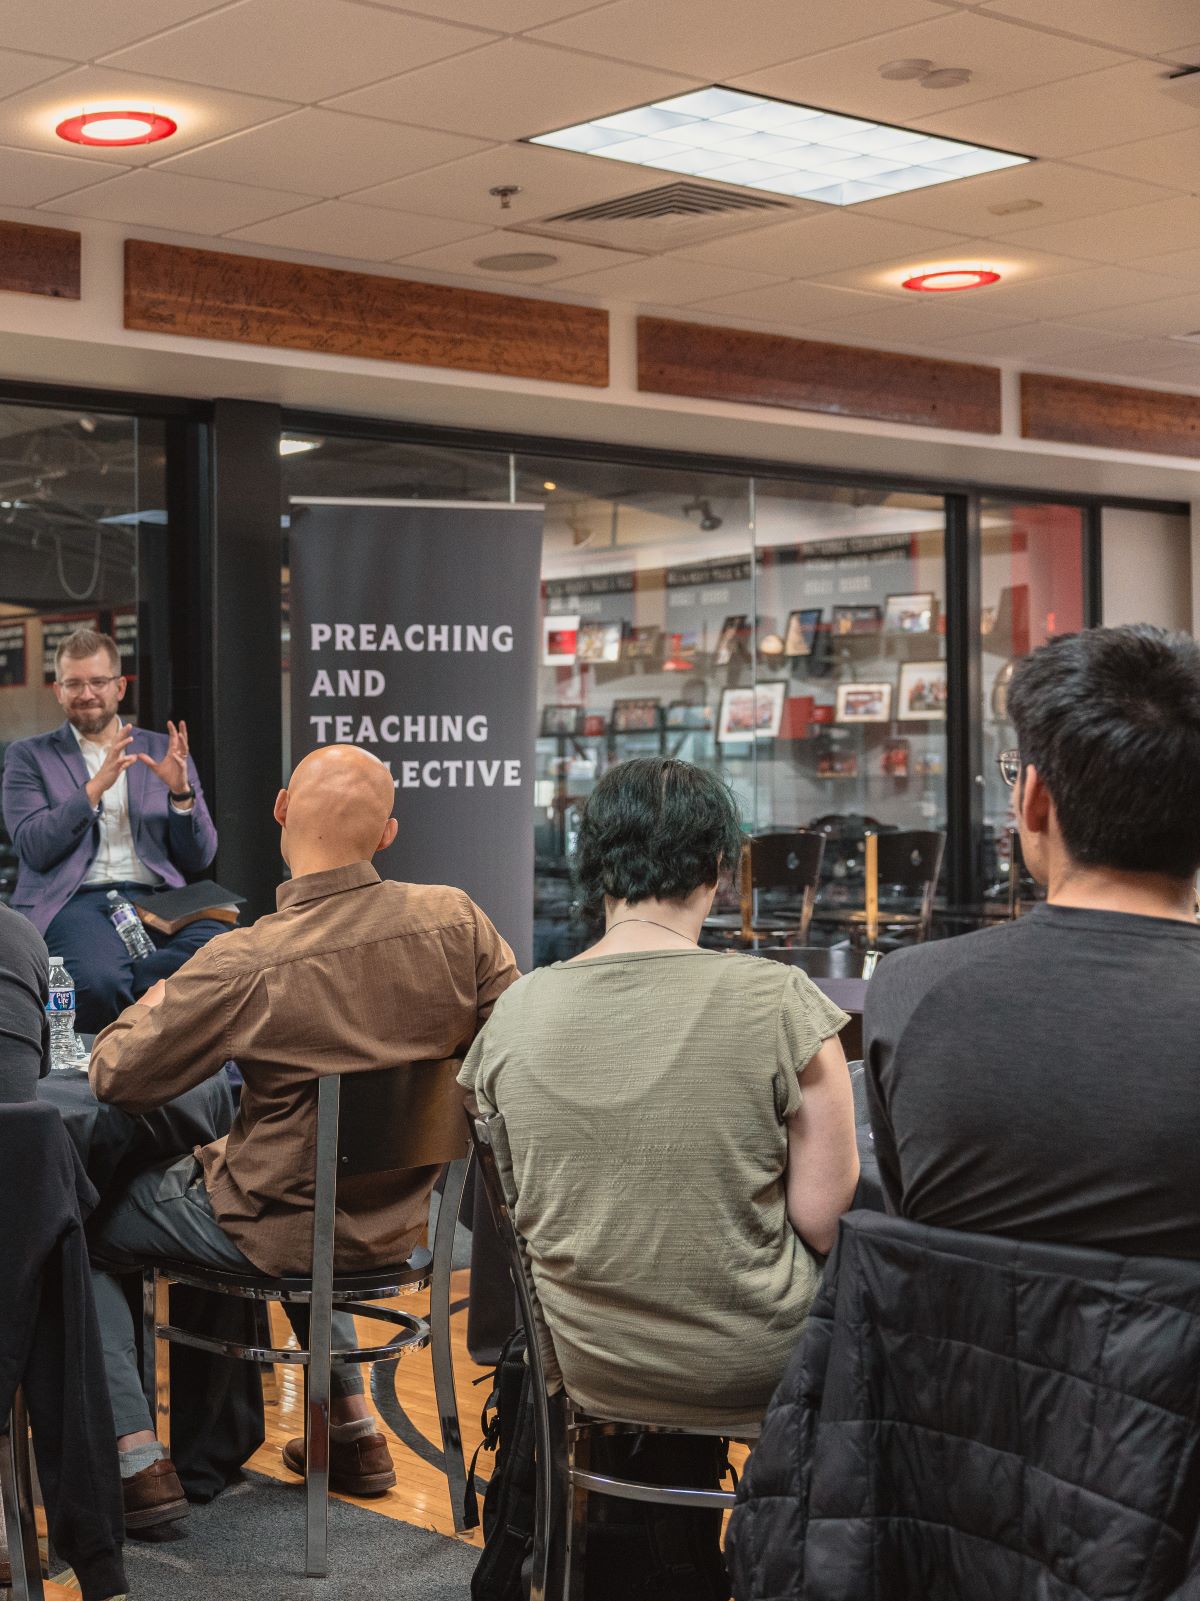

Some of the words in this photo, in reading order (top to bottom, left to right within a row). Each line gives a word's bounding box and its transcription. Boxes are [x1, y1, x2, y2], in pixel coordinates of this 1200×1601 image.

[310, 623, 513, 652] PREACHING
[310, 669, 386, 697] AND
[310, 715, 488, 743] TEACHING
